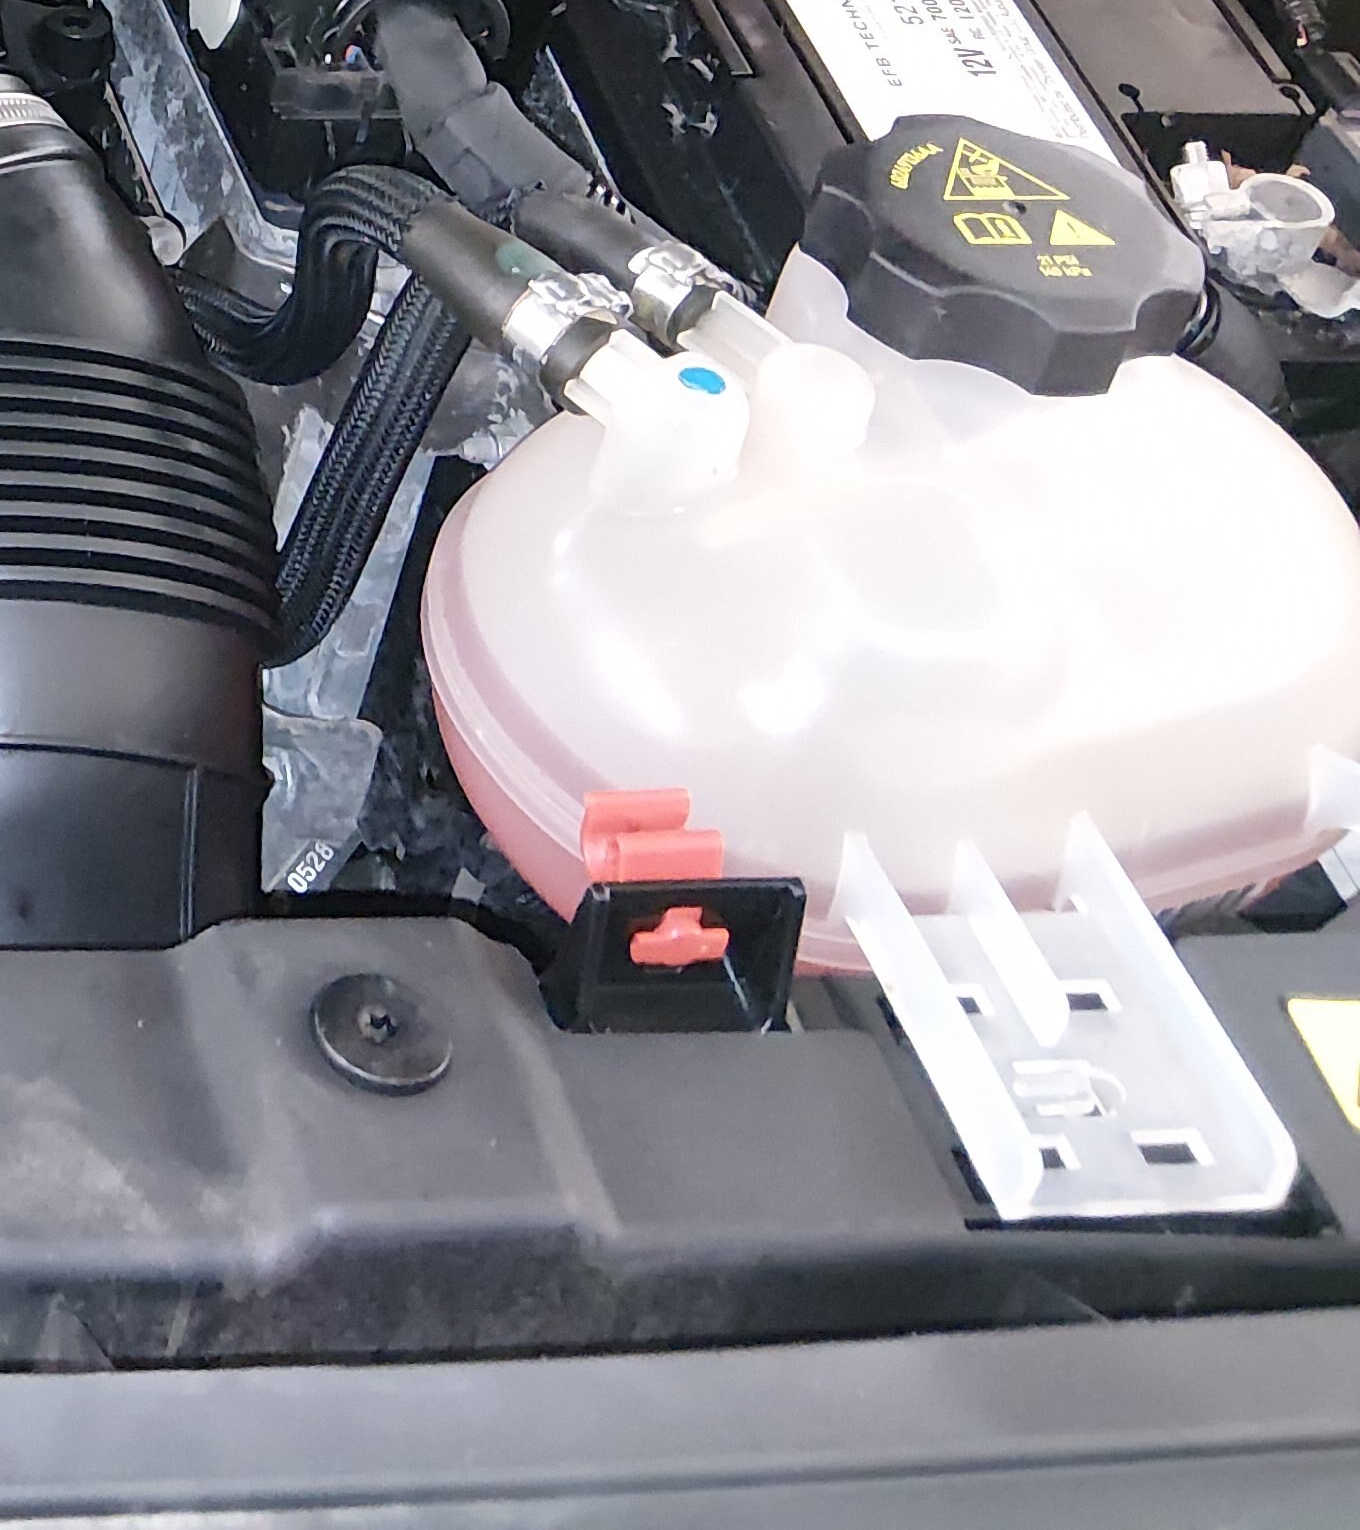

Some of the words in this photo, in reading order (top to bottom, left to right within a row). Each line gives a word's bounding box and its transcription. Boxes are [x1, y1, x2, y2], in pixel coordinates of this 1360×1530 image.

[875, 57, 903, 87] EFB
[953, 47, 997, 77] 12V
[287, 839, 335, 894] 0528
